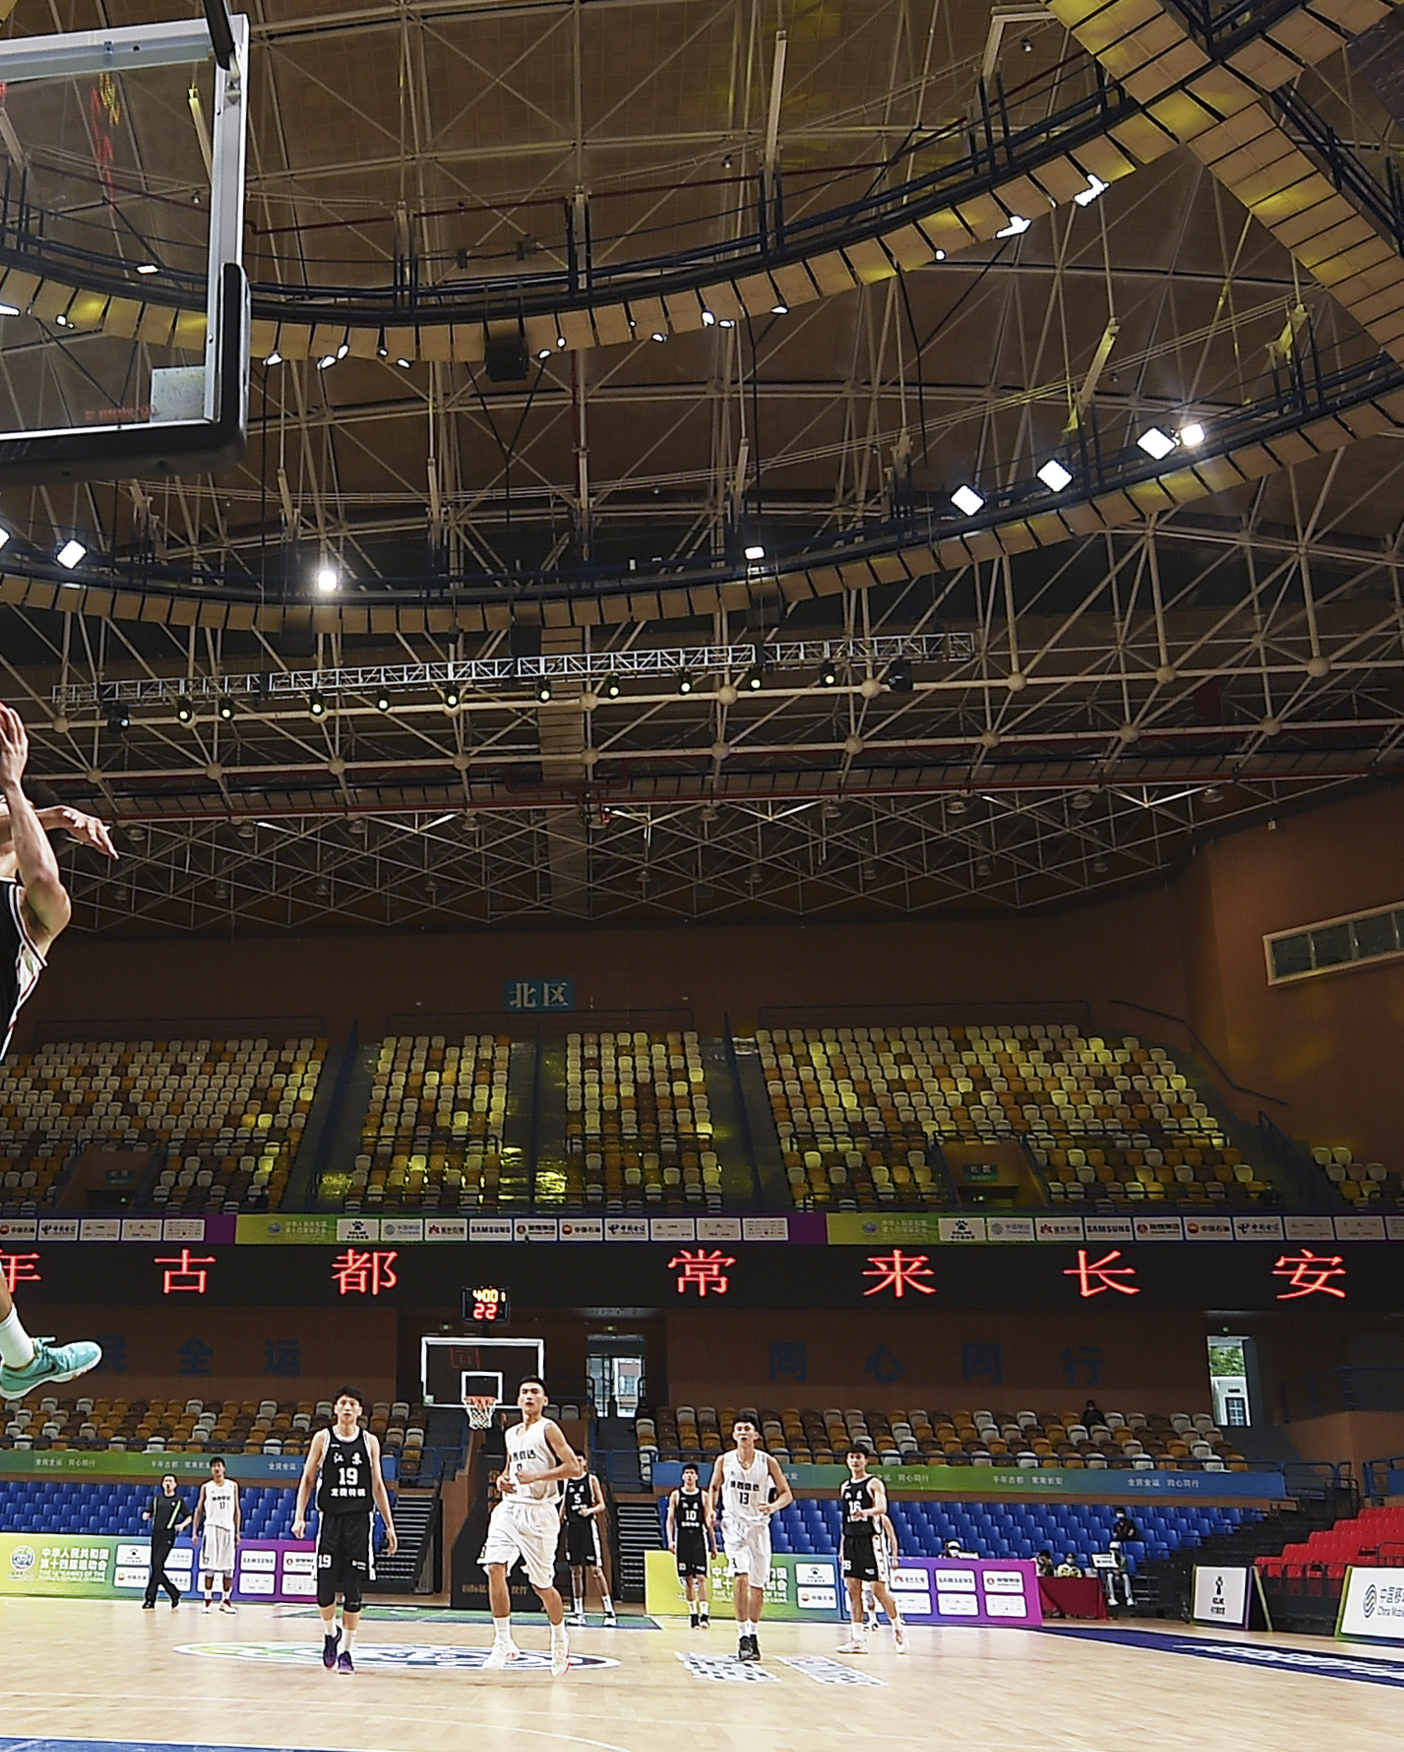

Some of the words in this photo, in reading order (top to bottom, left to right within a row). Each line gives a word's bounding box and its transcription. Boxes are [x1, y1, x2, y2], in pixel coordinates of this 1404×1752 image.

[508, 982, 569, 1008] 北区
[1087, 1225, 1130, 1233] SAMSUNG
[472, 1302, 498, 1320] 22
[338, 1467, 358, 1486] 19
[739, 1492, 749, 1505] 13
[685, 1510, 697, 1520] 10
[318, 1554, 332, 1568] 19
[1380, 1585, 1404, 1604] 中国移
